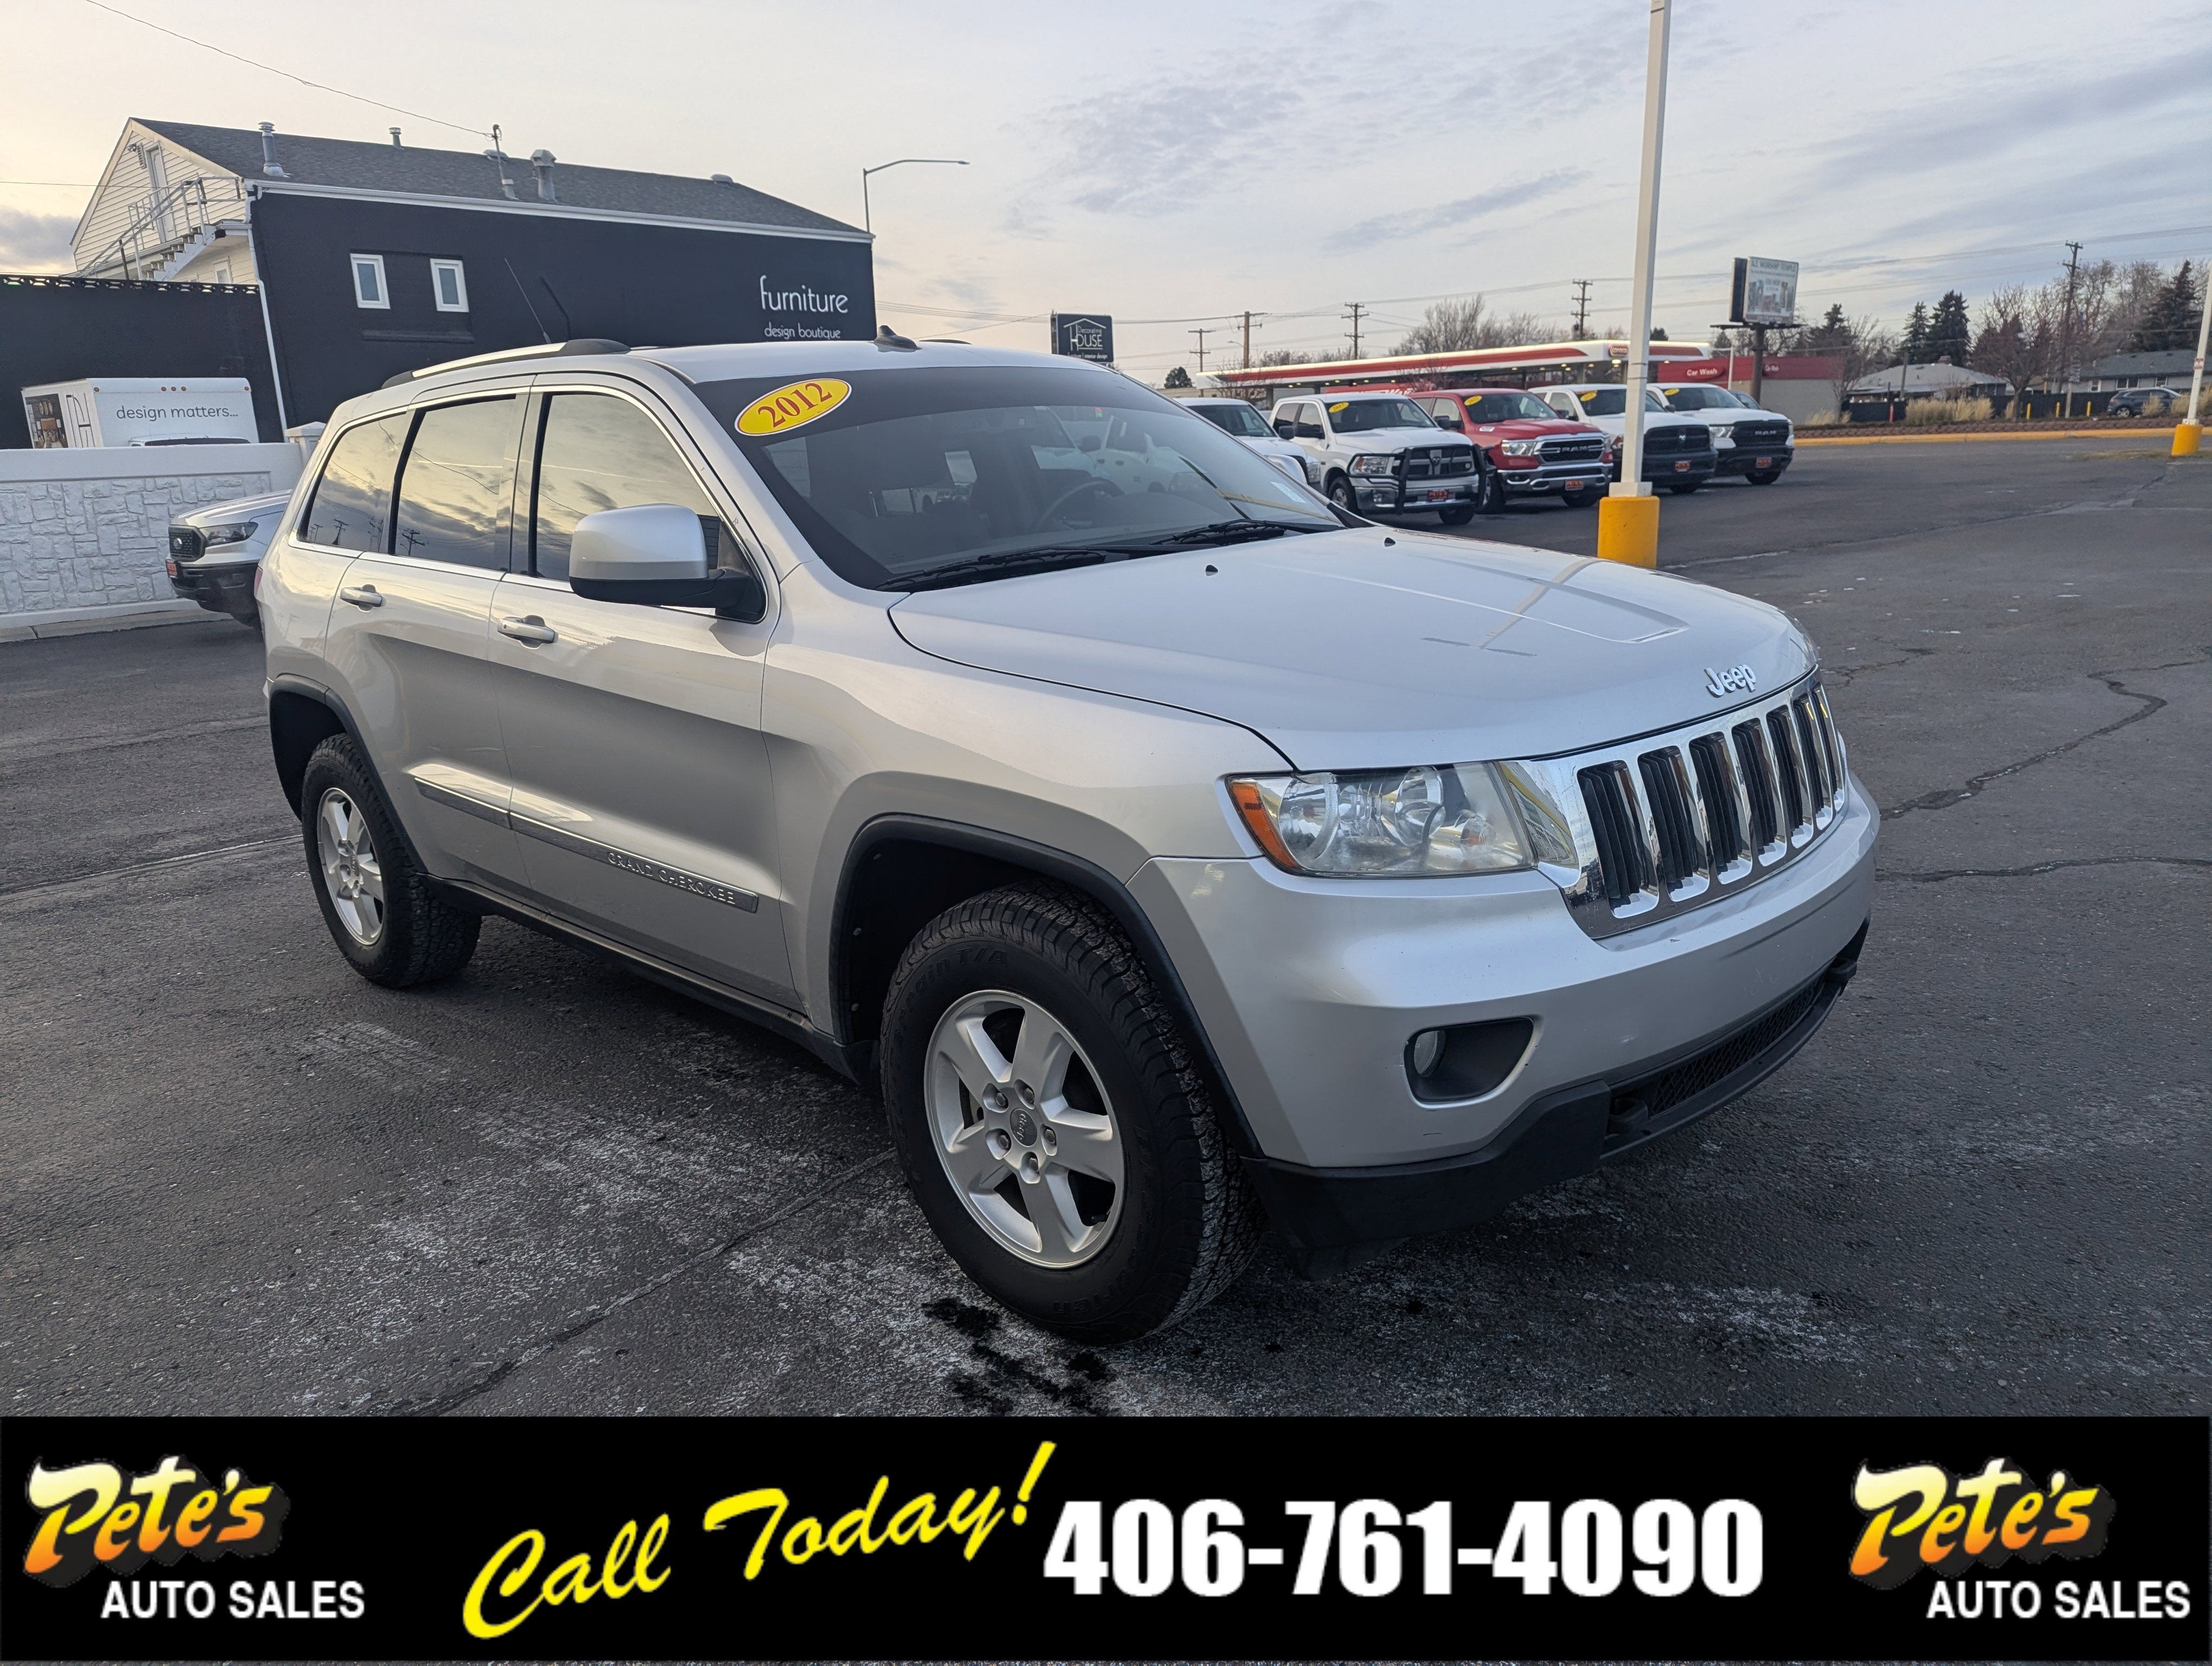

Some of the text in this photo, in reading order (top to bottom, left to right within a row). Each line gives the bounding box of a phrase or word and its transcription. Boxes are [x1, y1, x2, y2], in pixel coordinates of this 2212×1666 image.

[760, 275, 848, 313] furniture
[764, 322, 841, 340] design boutique
[1078, 326, 1102, 335] Decorating
[116, 406, 238, 421] design matters...
[758, 383, 833, 428] 2012
[1703, 664, 1757, 698] Jeep
[607, 851, 736, 905] GRAND CHEROKEE
